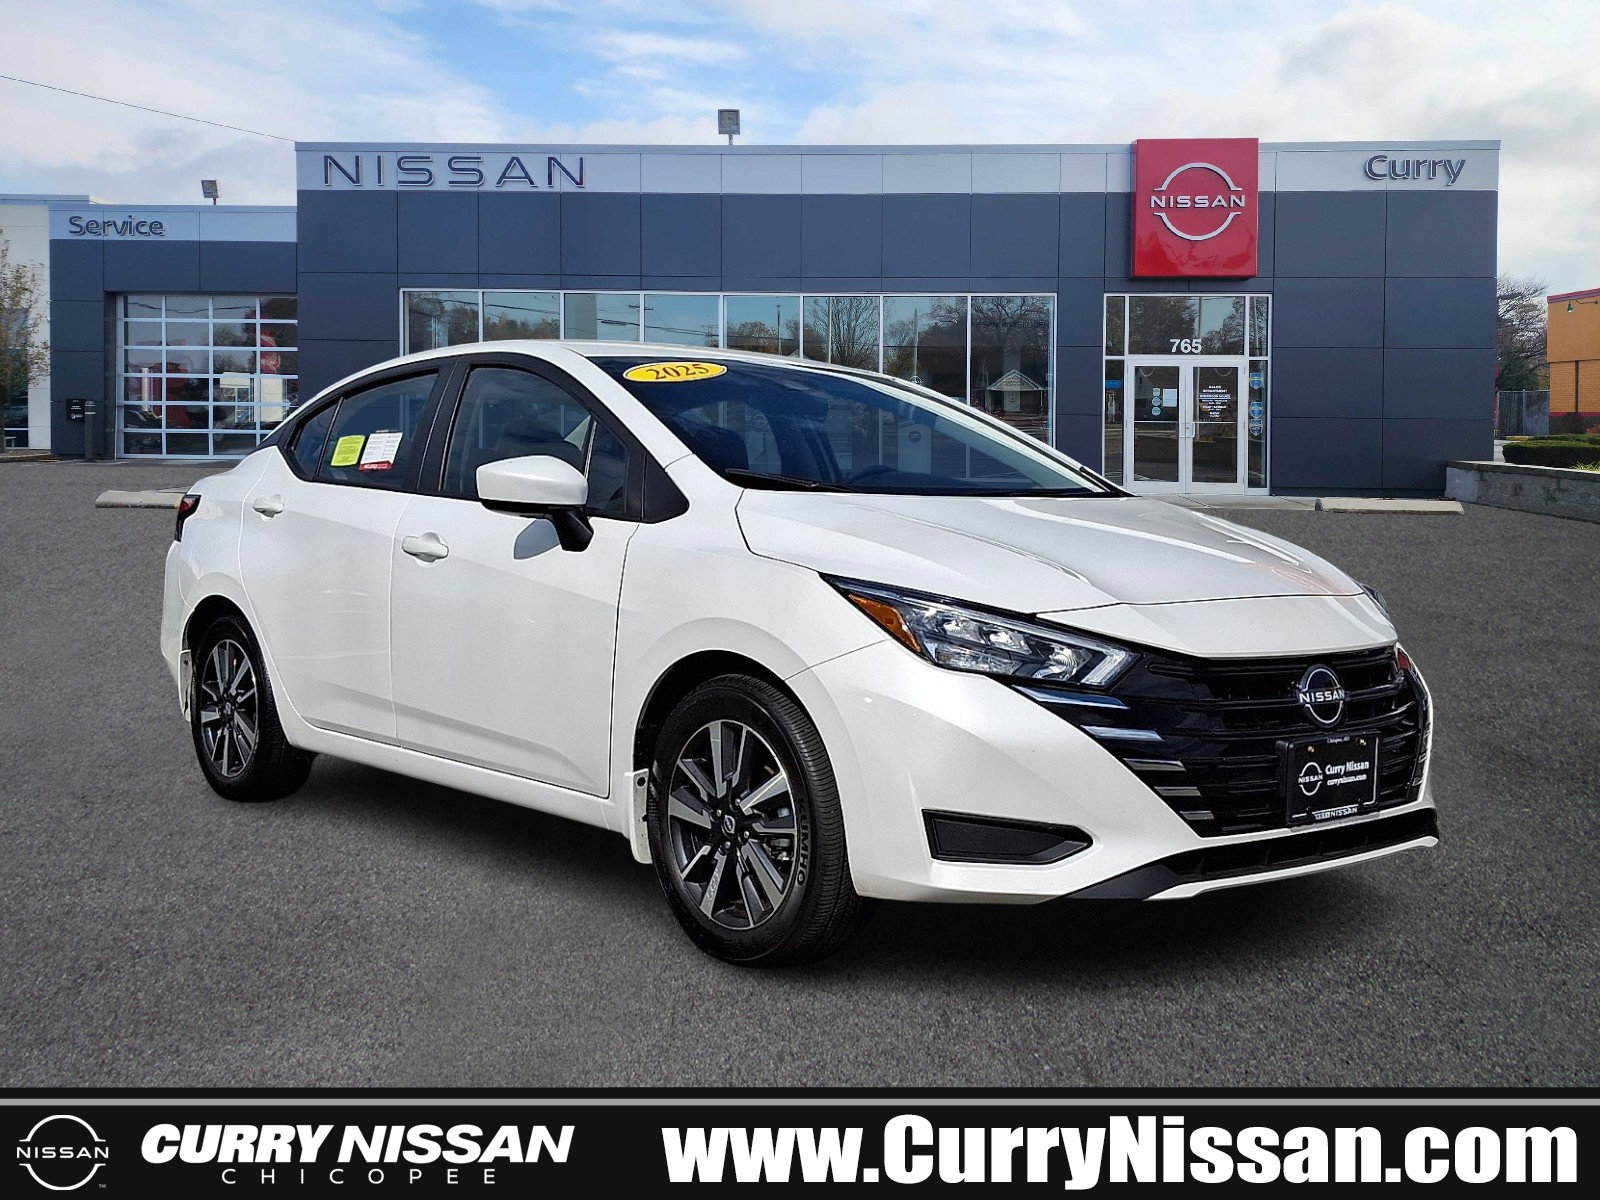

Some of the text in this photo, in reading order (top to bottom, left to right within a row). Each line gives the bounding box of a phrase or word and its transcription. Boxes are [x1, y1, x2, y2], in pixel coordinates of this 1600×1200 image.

[323, 155, 585, 188] NISSAN
[1365, 154, 1466, 186] Curry
[1150, 194, 1246, 209] NISSAN
[69, 214, 165, 237] Service
[1169, 338, 1202, 353] 765
[646, 363, 709, 380] 2025
[1299, 689, 1345, 703] NISSAN
[1325, 760, 1370, 776] Curry Nissan
[1298, 774, 1323, 784] NISSAN
[797, 799, 809, 886] KUMHO
